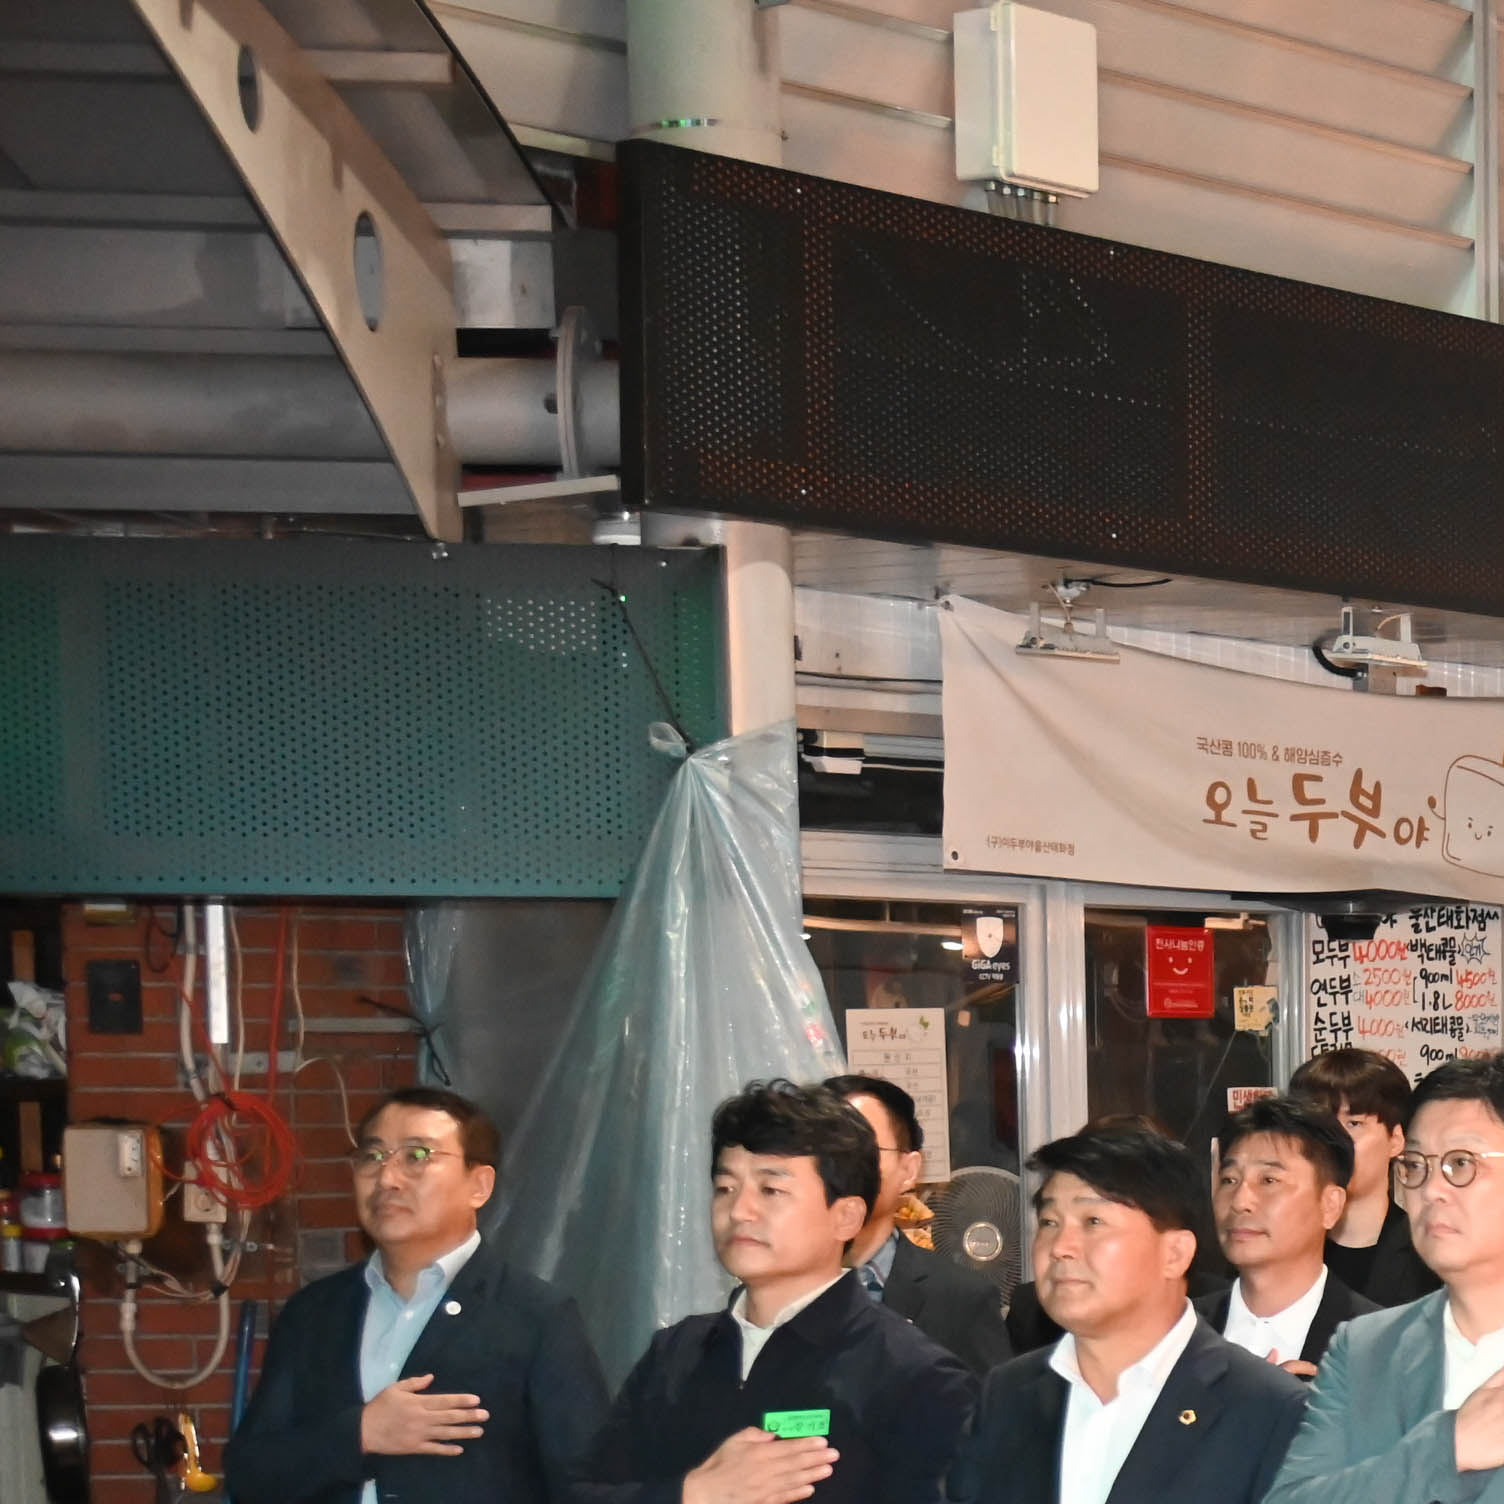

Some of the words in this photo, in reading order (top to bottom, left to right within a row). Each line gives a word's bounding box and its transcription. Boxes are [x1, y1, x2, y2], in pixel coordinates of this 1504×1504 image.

[1196, 736, 1233, 757] 국산콩
[1237, 741, 1268, 760] 100%
[1271, 745, 1280, 762] &
[1284, 747, 1344, 767] 해양심층수
[1202, 767, 1430, 849] 오늘두부야
[1312, 939, 1352, 968] 모두부
[1311, 974, 1353, 1008] 연두부
[1419, 967, 1453, 989] 900ml
[1313, 1011, 1354, 1043] 순두부
[1419, 1044, 1458, 1066] 900ml
